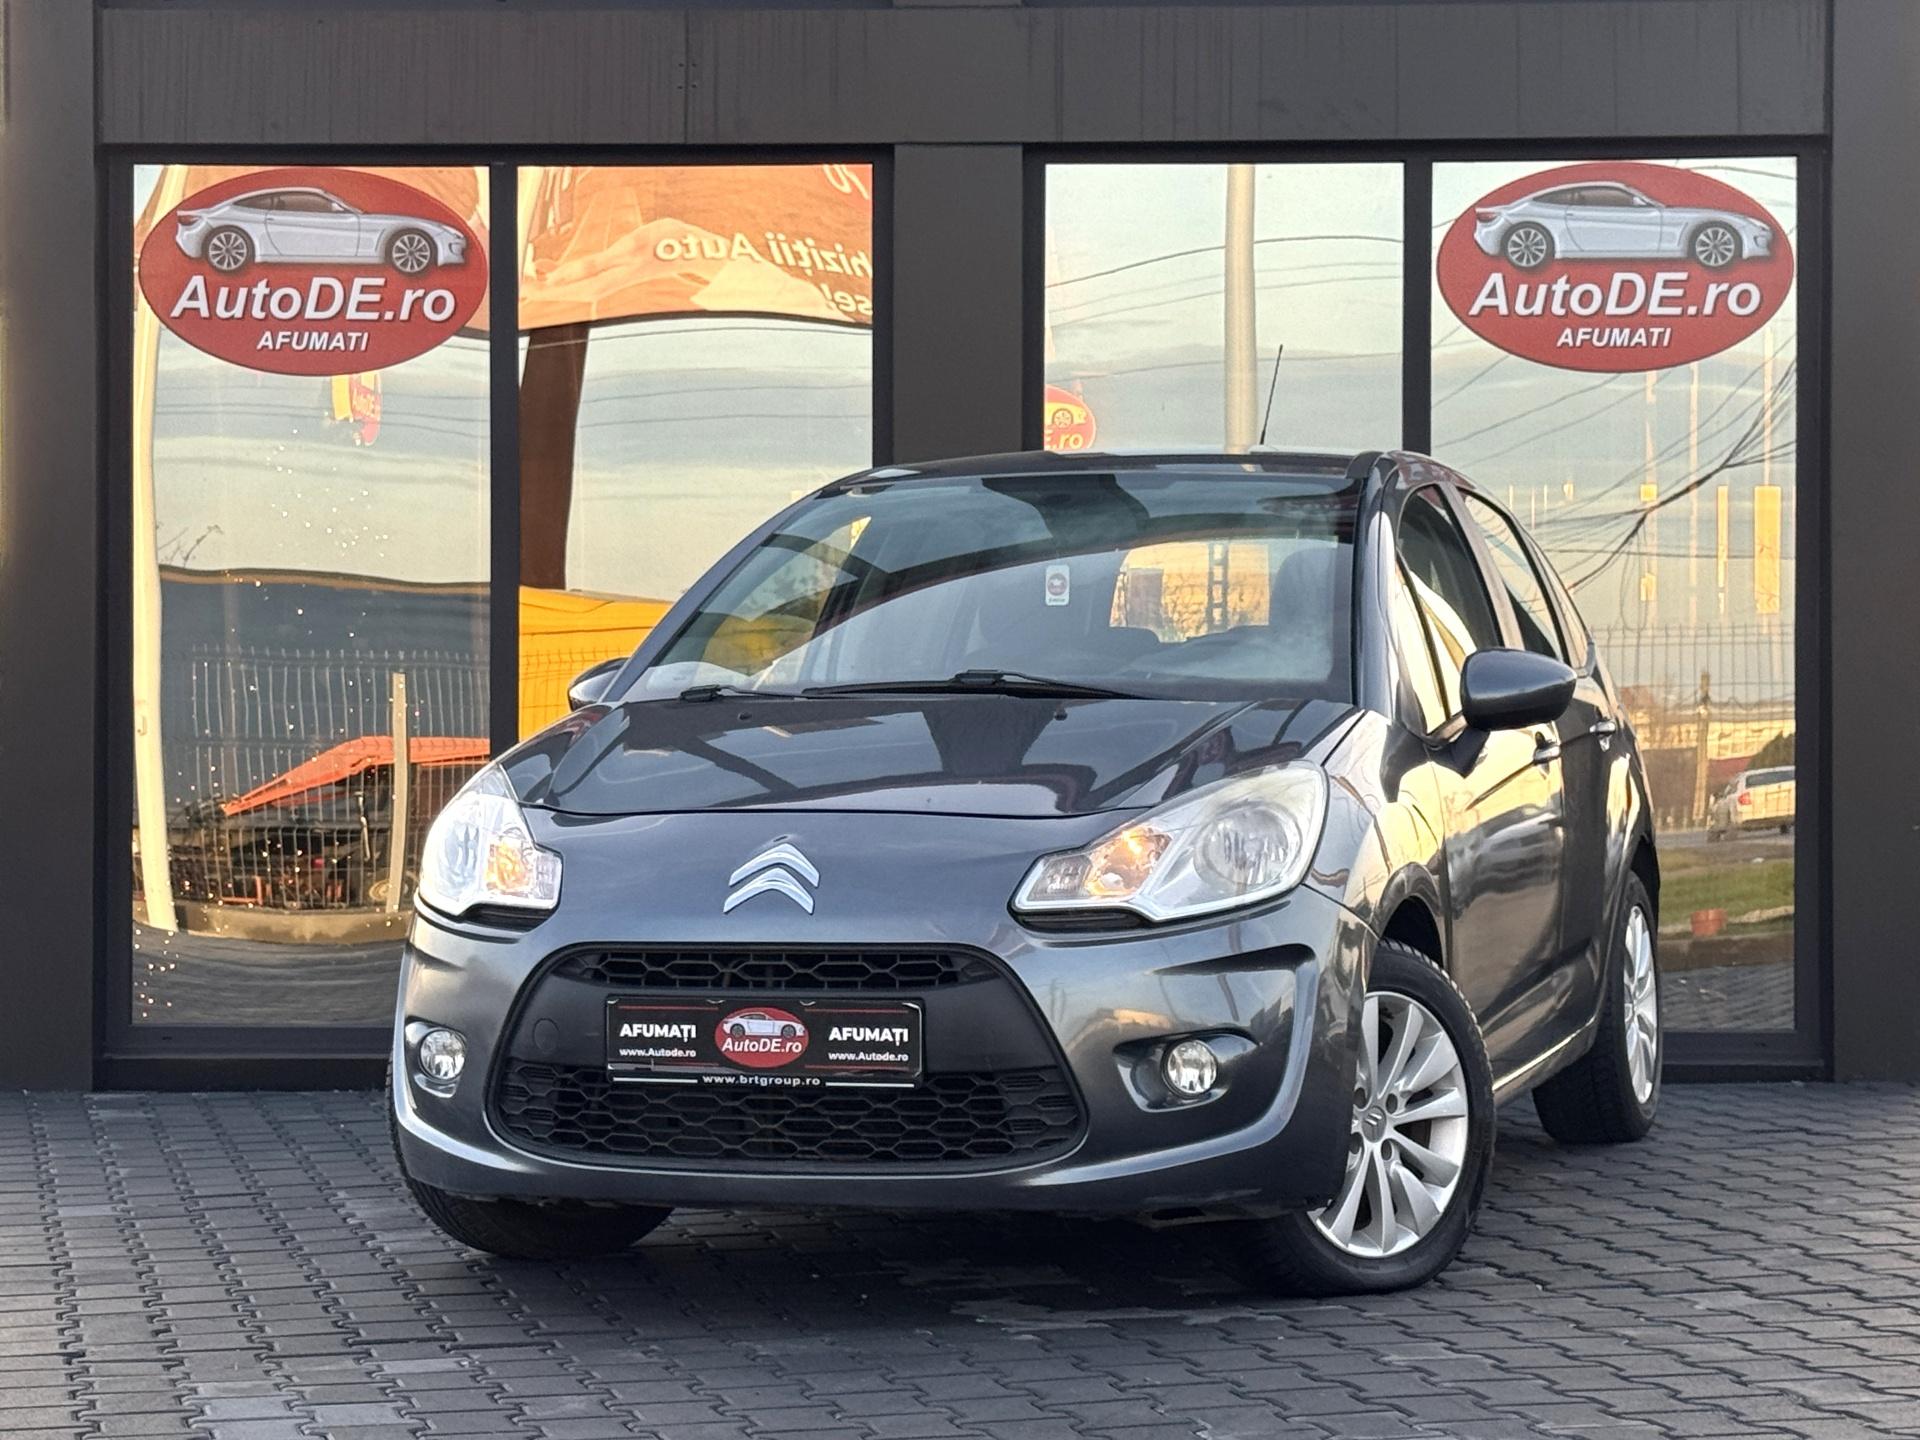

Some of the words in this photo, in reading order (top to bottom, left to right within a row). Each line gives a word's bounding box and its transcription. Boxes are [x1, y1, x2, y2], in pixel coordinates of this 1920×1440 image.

[171, 275, 456, 322] AutoDE.ro
[1468, 272, 1762, 317] AutoDE.ro
[257, 331, 369, 352] AFUMATI
[1557, 327, 1672, 347] AFUMATI
[620, 1023, 697, 1043] AFUMAȚI
[828, 1027, 909, 1046] AFUMAȚI
[619, 1047, 697, 1058] www.Autode.ro
[721, 1038, 803, 1053] AutoDE.ro
[828, 1051, 909, 1062] www.Autode.ro
[702, 1074, 821, 1087] www.brtgroup.ro
